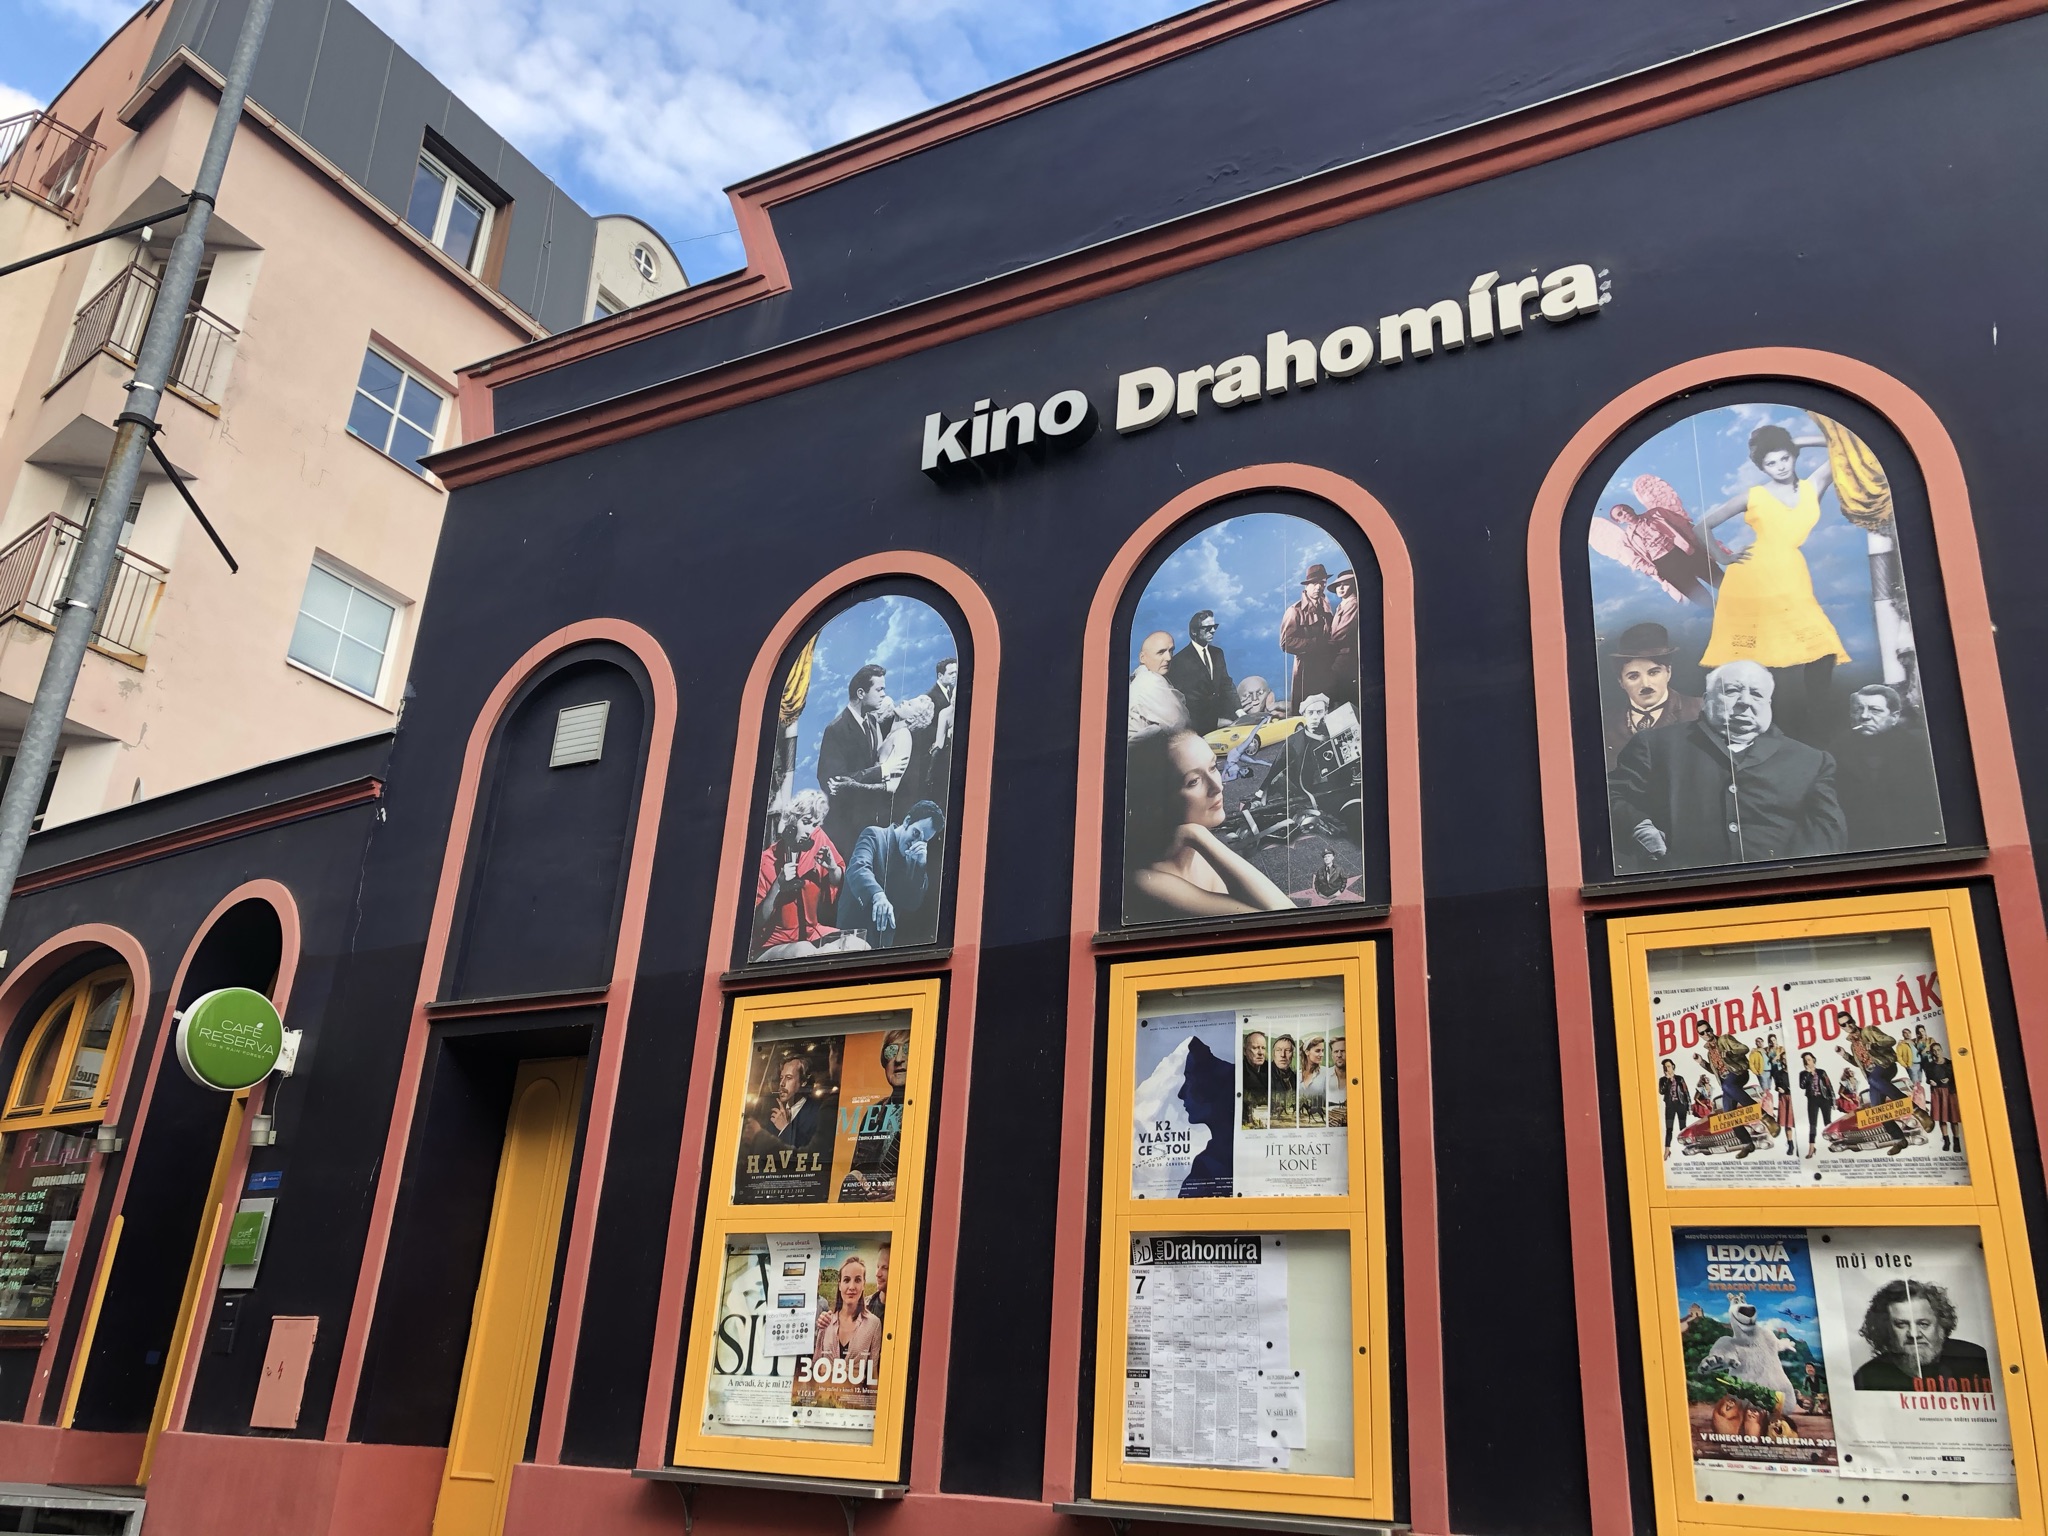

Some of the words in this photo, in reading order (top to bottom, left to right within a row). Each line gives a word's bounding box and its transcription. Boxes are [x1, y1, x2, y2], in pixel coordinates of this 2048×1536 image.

[921, 389, 1088, 473] kino
[1116, 263, 1601, 434] Drahomíra
[1793, 971, 1943, 1051] BOURÁK
[1810, 1001, 1820, 1009] HO
[221, 1020, 264, 1039] CAFÉ
[199, 1027, 274, 1056] RESERVA
[1723, 1109, 1745, 1120] KINECH
[1746, 1106, 1754, 1114] OD
[1868, 1112, 1893, 1125] ČERVNA
[1894, 1107, 1911, 1117] 2020
[1871, 1103, 1894, 1115] KINECH
[1895, 1100, 1904, 1108] OD
[1155, 1120, 1171, 1131] K2
[1720, 1117, 1743, 1130] ČERVNA
[1744, 1113, 1760, 1123] 2020
[1138, 1128, 1190, 1143] VLASTNÍ
[1138, 1143, 1190, 1156] CESTOU
[1265, 1142, 1283, 1158] JÍT
[1289, 1141, 1331, 1156] KRÁST
[746, 1150, 822, 1174] HAVEL
[1279, 1157, 1317, 1171] KONĚ
[1164, 1238, 1258, 1260] Drahomíra
[1706, 1241, 1790, 1262] LEDOVÁ
[1836, 1252, 1867, 1270] můj
[1875, 1252, 1913, 1269] otec
[1706, 1262, 1796, 1282] SEZÓNA
[1135, 1275, 1146, 1294] 7
[1758, 1283, 1797, 1292] POKLAD
[1900, 1393, 1997, 1411] kratochvíl
[1700, 1432, 1707, 1440] V
[1709, 1433, 1742, 1443] KINECH
[1744, 1435, 1758, 1443] OD
[1761, 1436, 1775, 1445] 19.
[1777, 1436, 1815, 1447] BŘEZNA
